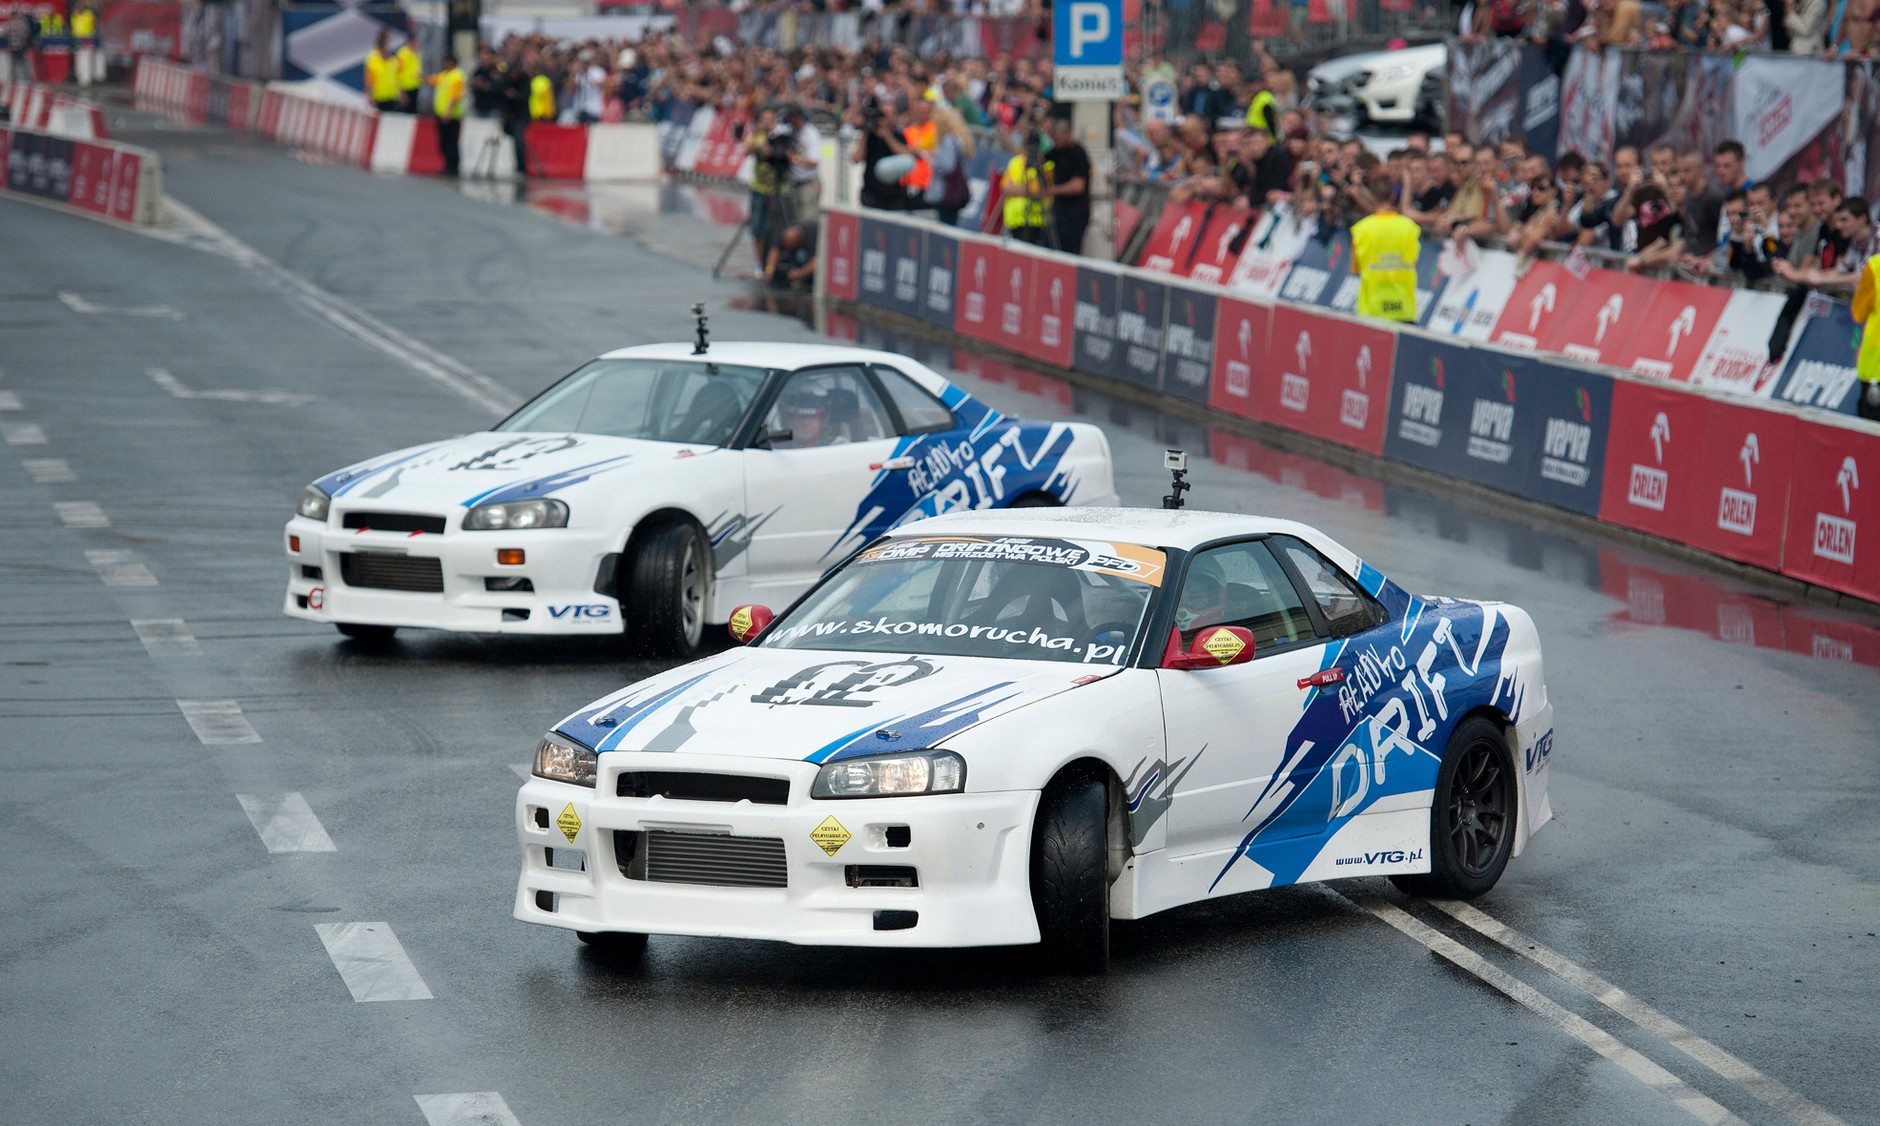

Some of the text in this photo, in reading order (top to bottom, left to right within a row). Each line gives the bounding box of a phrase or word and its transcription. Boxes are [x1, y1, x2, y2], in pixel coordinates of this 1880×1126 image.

[1069, 2, 1110, 58] P
[1632, 473, 1666, 506] ORLEN
[1722, 495, 1753, 531] ORLEN
[937, 543, 1085, 559] DRIFTINGOWE
[1817, 520, 1853, 556] ORLEN
[931, 551, 1080, 565] MISTRZOSTWA POLSKI
[547, 604, 610, 618] VTG
[765, 617, 1126, 664] www.skomorucha.pl
[1339, 643, 1390, 725] READY
[1327, 616, 1478, 823] DRIFT
[1525, 727, 1553, 775] VTG
[1335, 848, 1423, 866] www.VTG.pl
